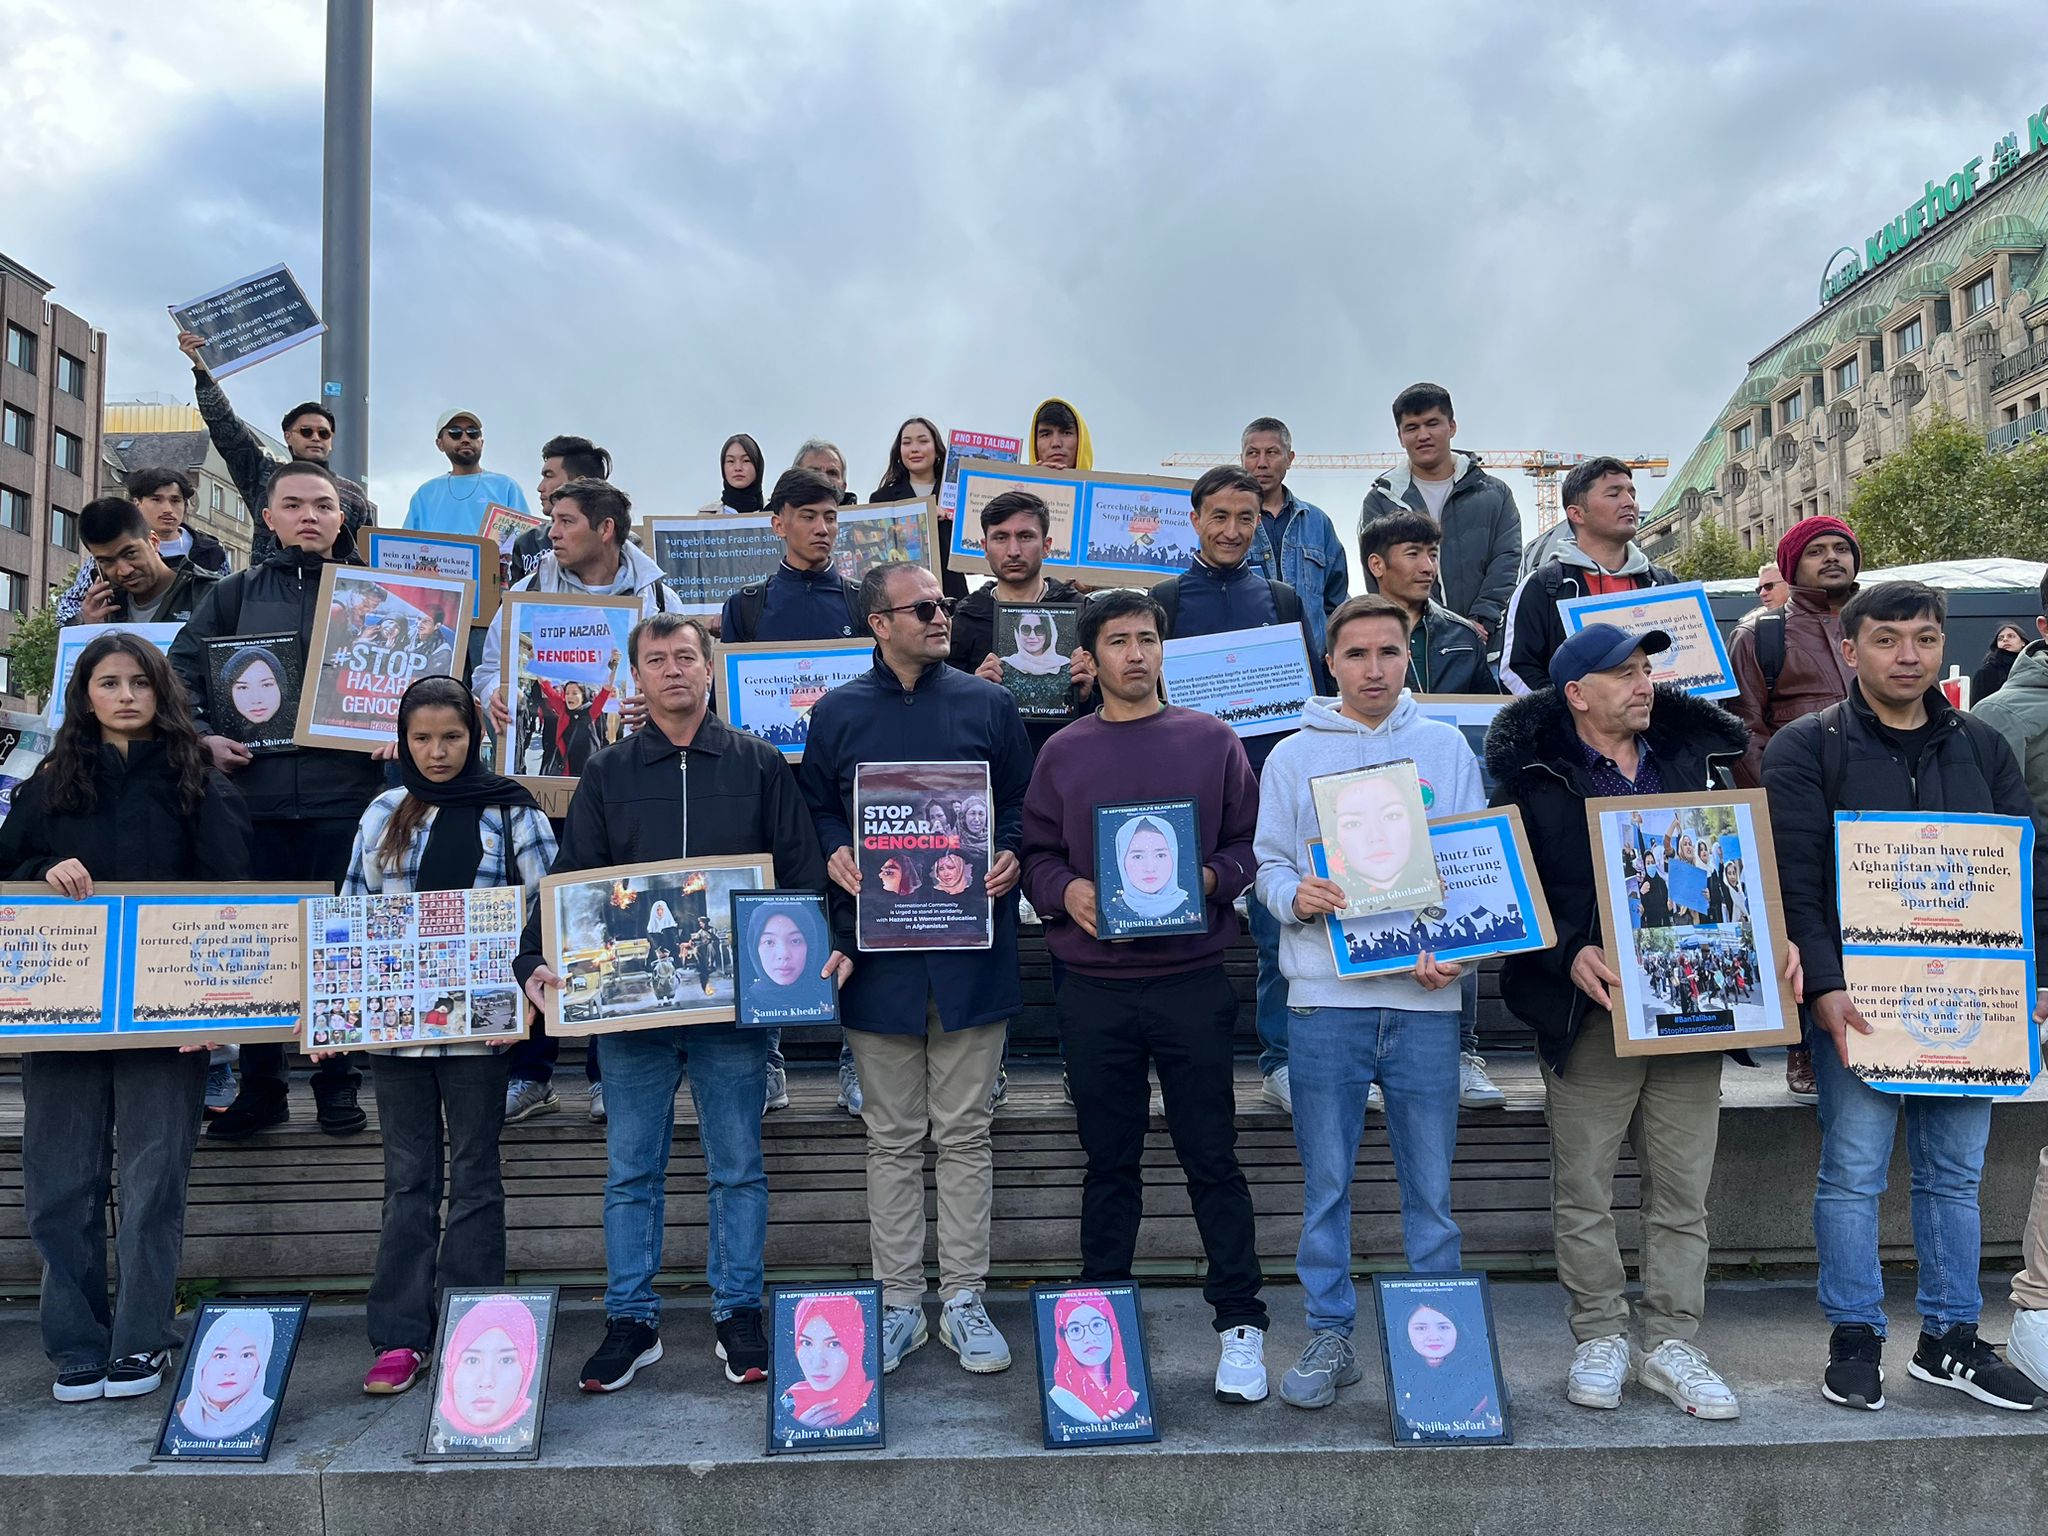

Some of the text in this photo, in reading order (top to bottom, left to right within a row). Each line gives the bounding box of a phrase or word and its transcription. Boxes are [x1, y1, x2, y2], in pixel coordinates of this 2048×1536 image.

[1993, 132, 2017, 161] AN
[1989, 149, 2021, 180] DER
[192, 276, 280, 315] Nur Ausgebildete Frauen
[191, 284, 287, 327] bringen Afghanistan weiter
[237, 316, 264, 331] Frauen
[263, 308, 287, 321] lassen
[287, 300, 302, 312] sich
[219, 315, 294, 350] nicht von den Taliban
[237, 331, 286, 354] kontrollieren.
[955, 432, 1016, 450] #NO TO TALIBAN
[1096, 501, 1189, 517] Gerechtigkeit für Hazar
[1102, 512, 1190, 527] Stop Hazara Genocide
[670, 535, 726, 547] ungebildete
[728, 534, 761, 545] Frauen
[383, 551, 400, 560] nein
[401, 553, 411, 561] zu
[668, 545, 781, 559] leichter zu kontrollieren.
[384, 560, 468, 576] Stop Hazara Genocide
[667, 572, 767, 587] gebildete Frauen sind
[678, 588, 709, 599] Gefahr
[711, 587, 726, 598] für
[1635, 619, 1658, 628] women
[1659, 616, 1672, 625] and
[1673, 614, 1688, 624] girls
[1679, 622, 1703, 632] of their
[540, 623, 611, 639] STOP HAZARA
[1670, 643, 1697, 653] Taliban.
[332, 643, 427, 678] #STOP
[744, 674, 814, 686] Gerechtigkeit
[815, 672, 829, 681] für
[754, 686, 818, 698] Stop Hazara
[342, 695, 402, 717] GENOC
[1031, 705, 1067, 715] Urozgani
[864, 805, 913, 819] STOP
[864, 820, 945, 834] HAZARA
[864, 835, 961, 850] GENOCIDE
[1472, 845, 1493, 857] für
[1853, 843, 2005, 858] The Taliban have ruled
[1439, 860, 1502, 877] ölkerung
[1849, 860, 2011, 878] Afghanistan with gender,
[1868, 878, 1996, 892] religious and ethnic
[1901, 897, 1969, 910] apartheid.
[172, 921, 290, 931] Girls and women are
[912, 923, 949, 931] Afghanistan
[1119, 916, 1186, 929] Husnia Azimi
[39, 925, 98, 936] Criminal
[4, 941, 91, 954] fulfill its duty
[140, 934, 299, 948] tortured, raped and impriso
[190, 948, 270, 961] by the Taliban
[16, 957, 73, 971] genocide
[76, 956, 89, 967] of
[148, 964, 199, 974] warlords
[202, 963, 213, 972] in
[217, 961, 288, 973] Afghanistan;
[21, 973, 67, 986] people.
[184, 975, 274, 987] world is silence!
[1850, 982, 2020, 997] For more than two years, girls have
[1853, 995, 2019, 1009] been deprived of education, school
[753, 1007, 822, 1018] Samira Khedri
[1674, 1015, 1717, 1024] #BanTaliban
[1880, 1010, 1930, 1022] university
[1933, 1011, 1964, 1021] under
[1966, 1012, 1981, 1021] the
[1983, 1012, 2016, 1022] Taliban
[1660, 1023, 1734, 1035] #StopHazaraGenocide
[1923, 1026, 1961, 1035] regime.
[788, 1426, 864, 1440] Zahra Ahmadi
[1063, 1420, 1140, 1434] Fereshta Rezai
[1416, 1420, 1486, 1433] Najiba Safari
[173, 1438, 216, 1449] Nazanin
[450, 1434, 511, 1446] Faiza Amiri
